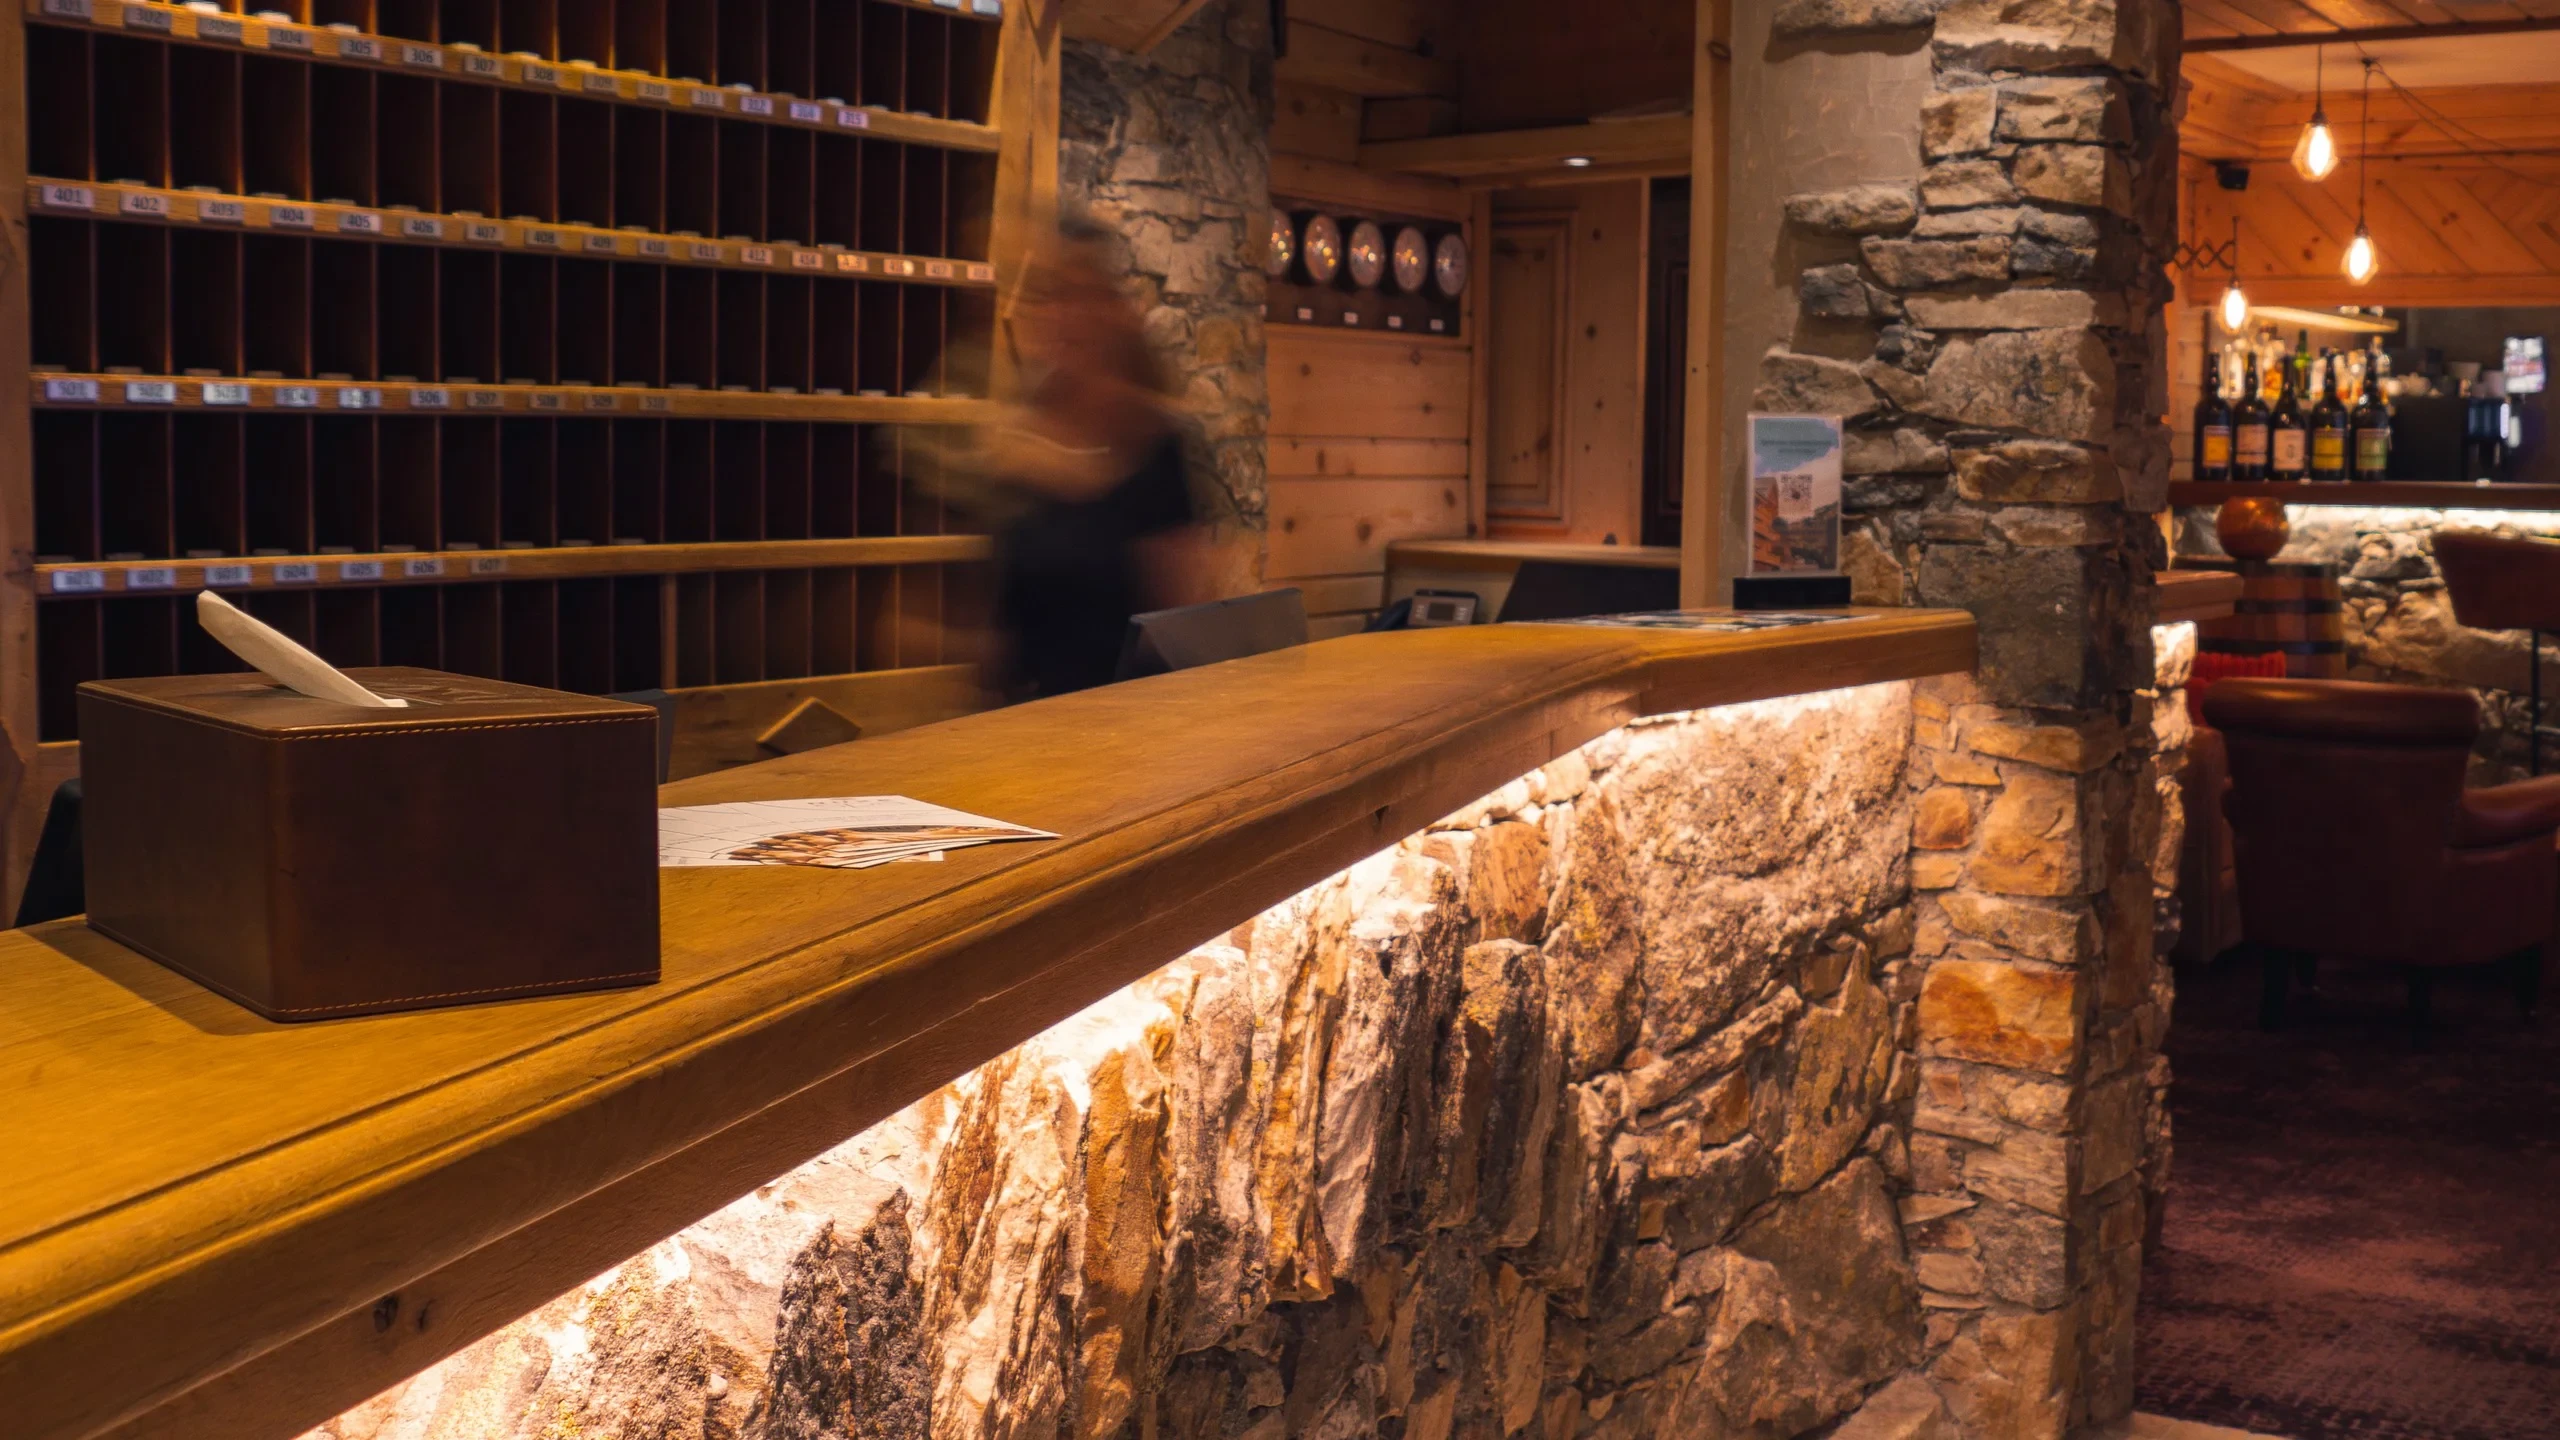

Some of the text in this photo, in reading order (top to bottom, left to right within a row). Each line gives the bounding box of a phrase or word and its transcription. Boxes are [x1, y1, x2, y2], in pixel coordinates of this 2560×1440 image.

[136, 8, 162, 24] 302
[279, 30, 303, 45] 304
[347, 39, 371, 54] 305
[412, 48, 434, 63] 306
[474, 57, 496, 72] 307
[54, 187, 83, 204] 401
[131, 195, 160, 211] 402
[208, 202, 234, 216] 403
[279, 208, 304, 222] 404
[347, 214, 370, 228] 405
[411, 220, 434, 234] 406
[475, 225, 496, 239] 407
[534, 231, 555, 244] 408
[591, 235, 611, 249] 409
[748, 248, 766, 262] 412
[418, 391, 441, 405] 506
[475, 391, 497, 405] 507
[283, 564, 309, 579] 604
[413, 560, 436, 573] 606
